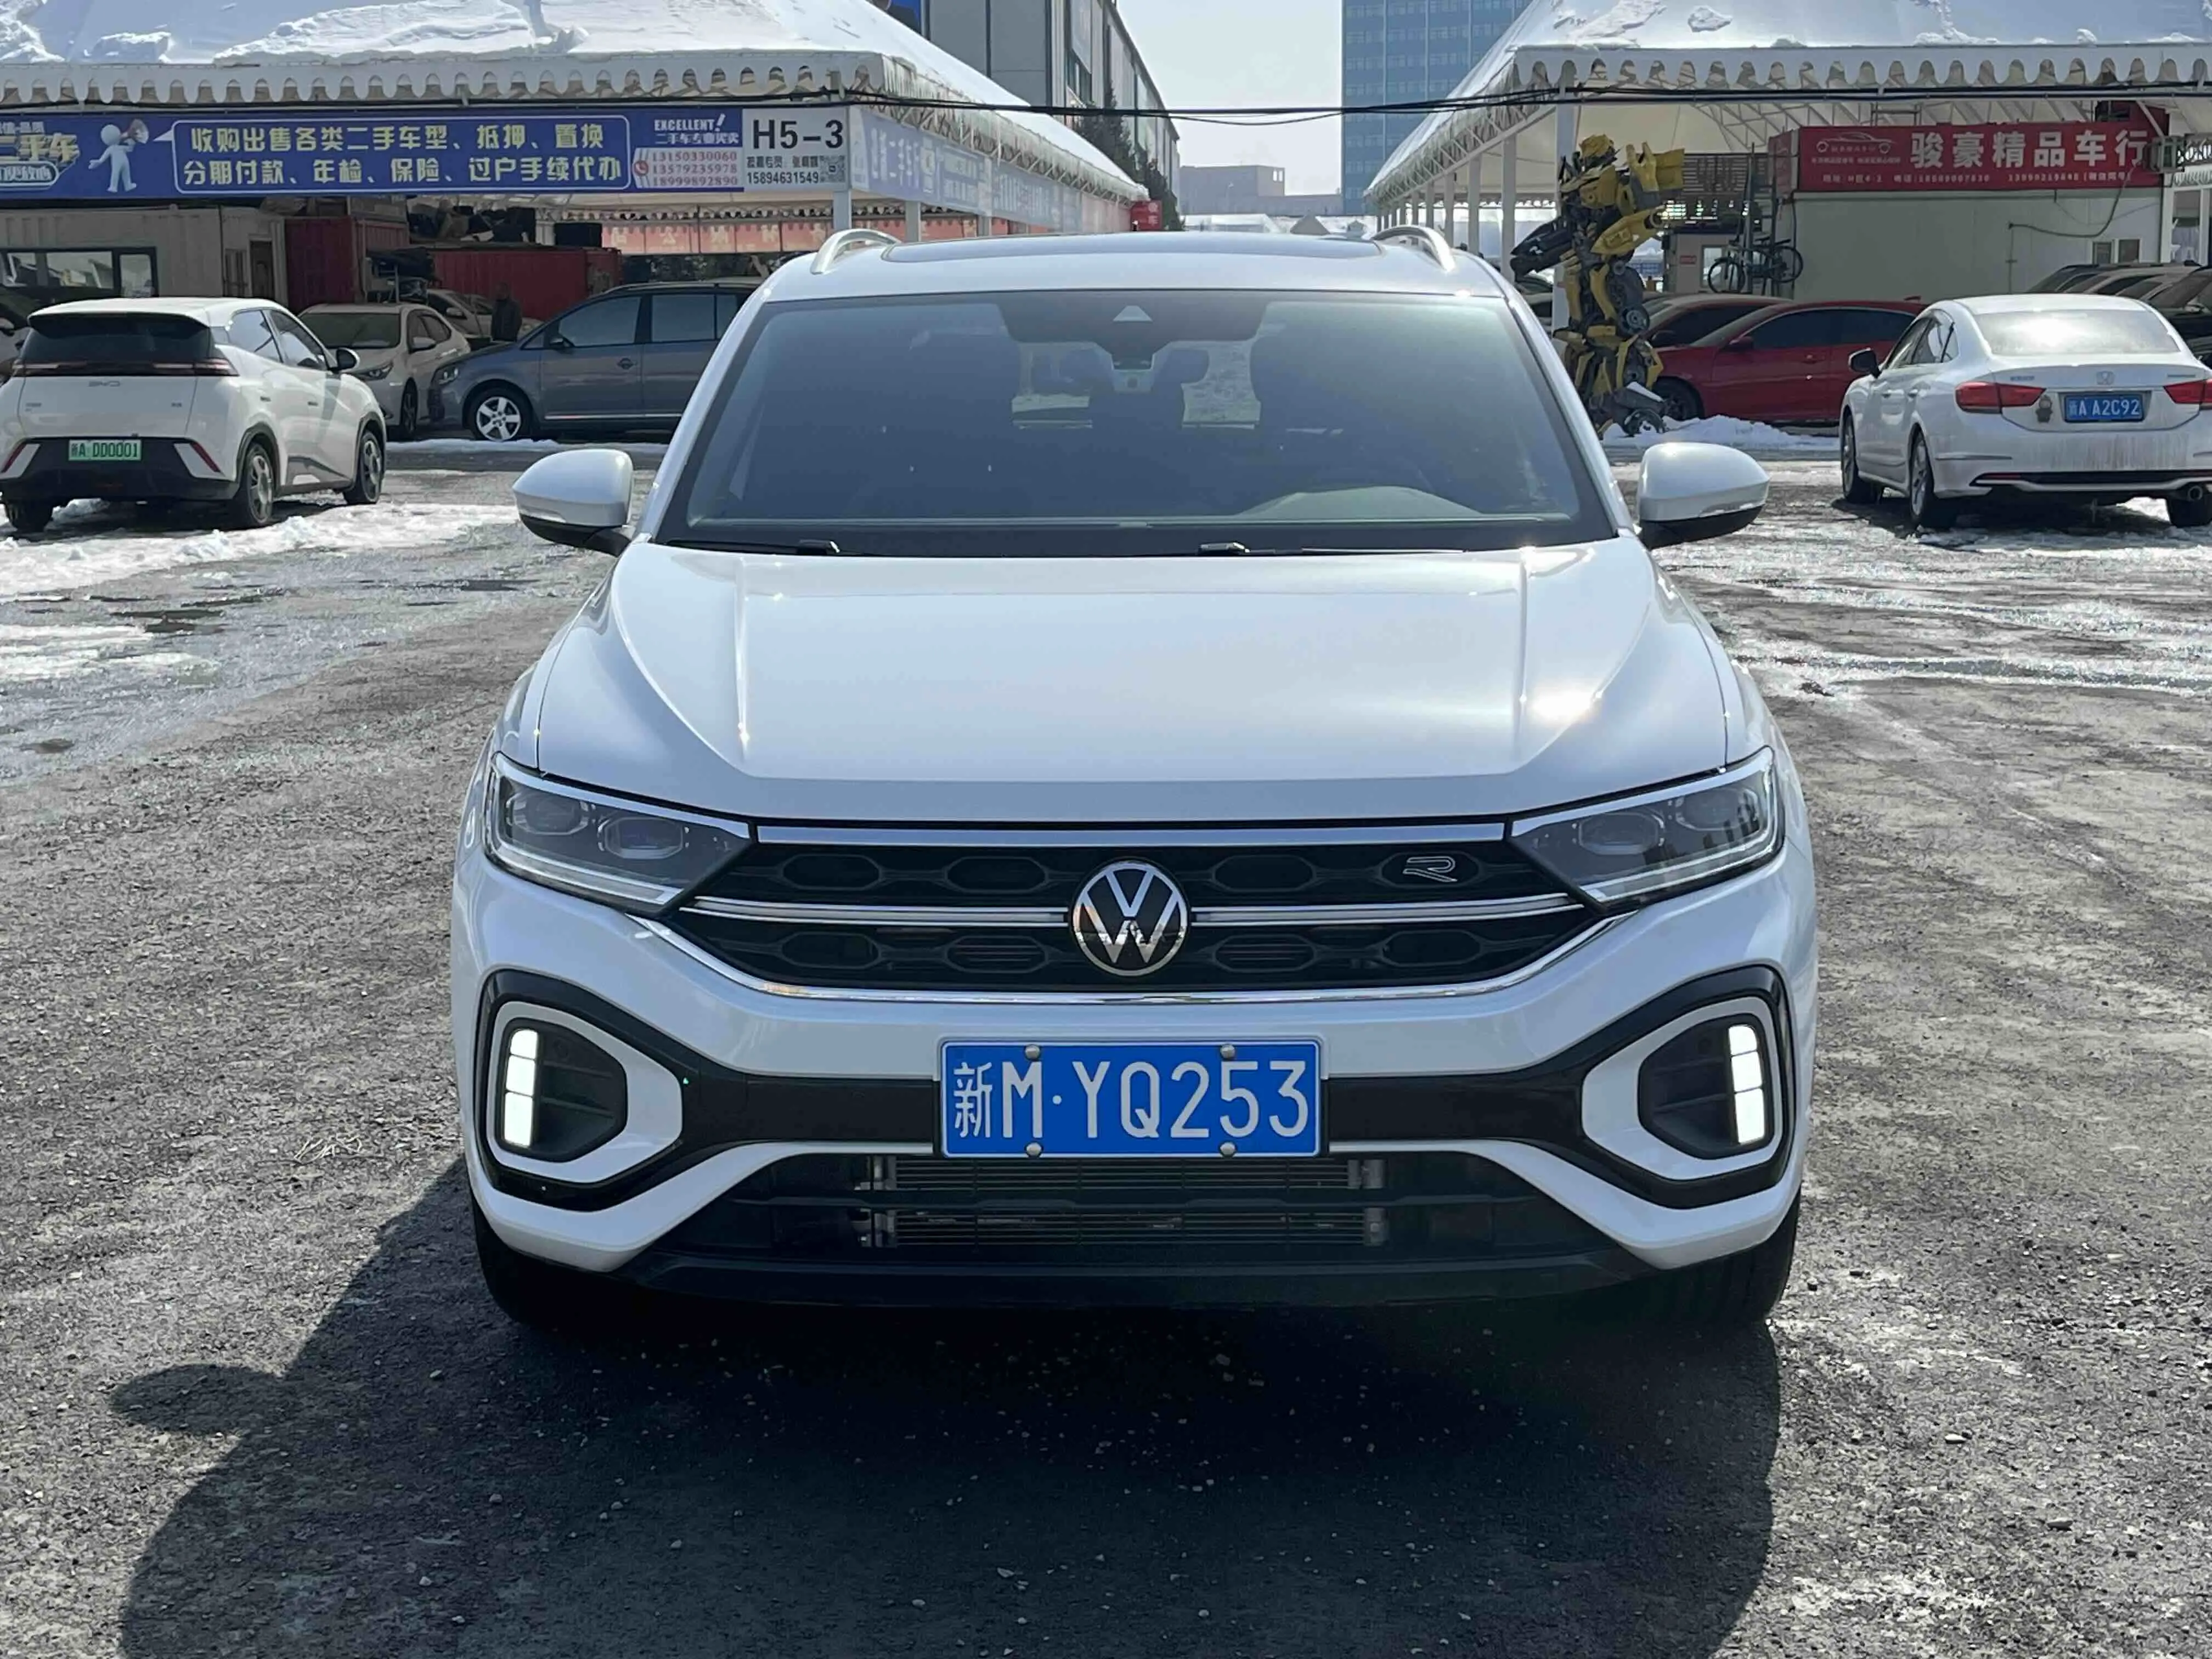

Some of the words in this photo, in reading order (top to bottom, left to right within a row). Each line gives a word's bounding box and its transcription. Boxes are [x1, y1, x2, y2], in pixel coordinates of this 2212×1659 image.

[753, 119, 844, 150] H5-3
[1910, 129, 2148, 168] 骏豪精品车行
[184, 156, 622, 185] 分期付款、年检、保险、过户手续代办
[747, 171, 819, 184] 15894631549
